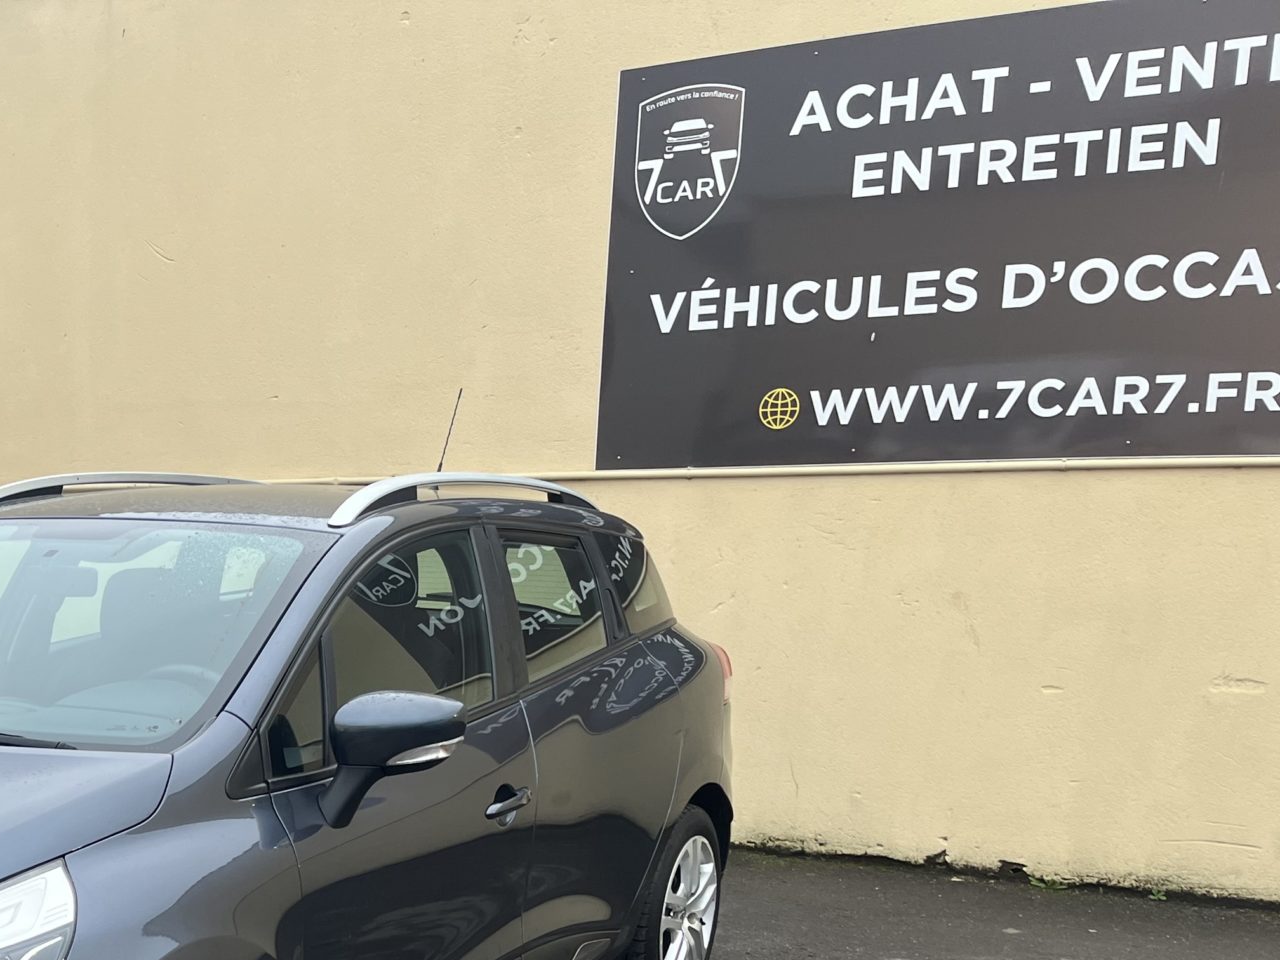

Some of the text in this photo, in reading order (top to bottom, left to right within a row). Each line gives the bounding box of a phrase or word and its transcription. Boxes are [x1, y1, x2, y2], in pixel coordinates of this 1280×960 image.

[645, 104, 656, 112] En
[656, 96, 676, 108] route
[676, 93, 692, 102] vers
[700, 90, 735, 100] confiance
[790, 66, 1010, 136] ACHAT
[1076, 33, 1280, 102] VENT
[851, 118, 1221, 198] ENTRETIEN
[650, 248, 1280, 334] VÉHICULES D'OCCA
[809, 371, 1280, 426] WWW.7CAR7.FR
